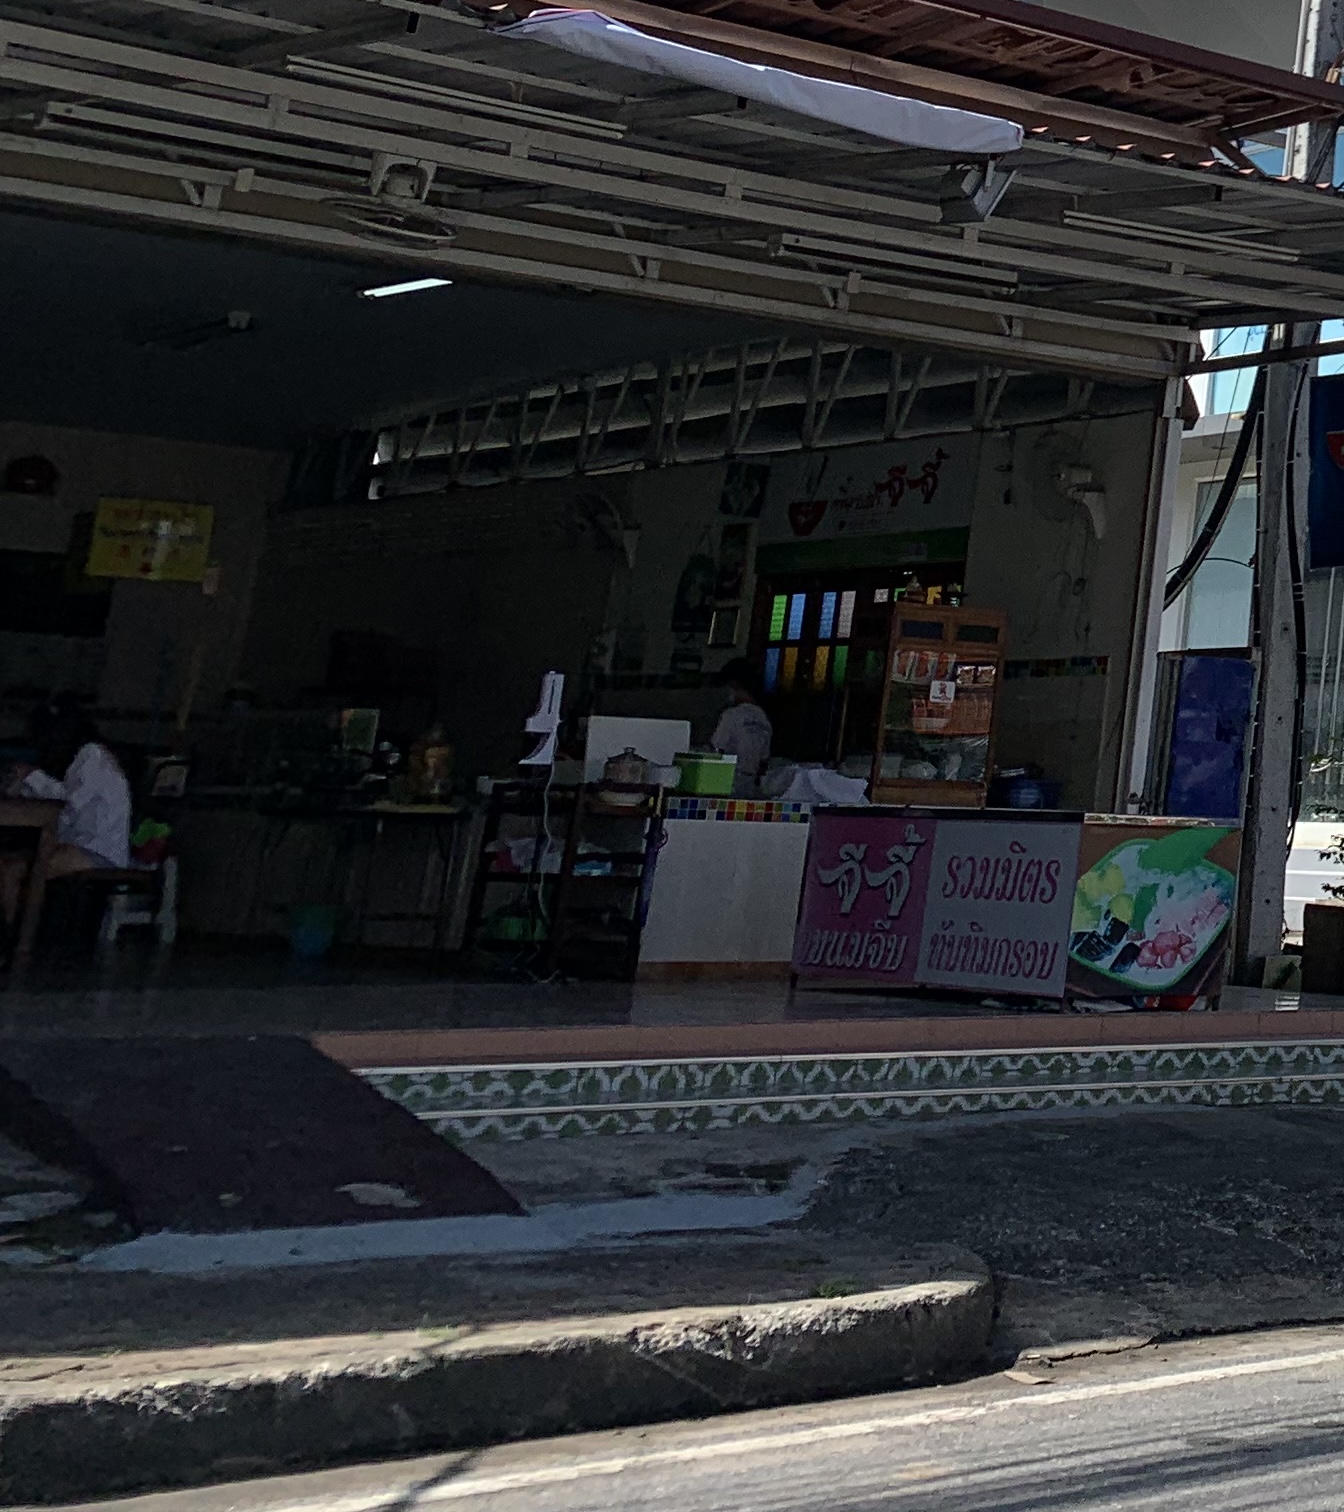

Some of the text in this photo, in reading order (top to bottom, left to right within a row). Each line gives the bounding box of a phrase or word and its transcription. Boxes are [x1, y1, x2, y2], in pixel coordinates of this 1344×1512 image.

[941, 840, 1062, 906] รวมมิตร
[927, 919, 1061, 981] ทับทิมกรอบ
